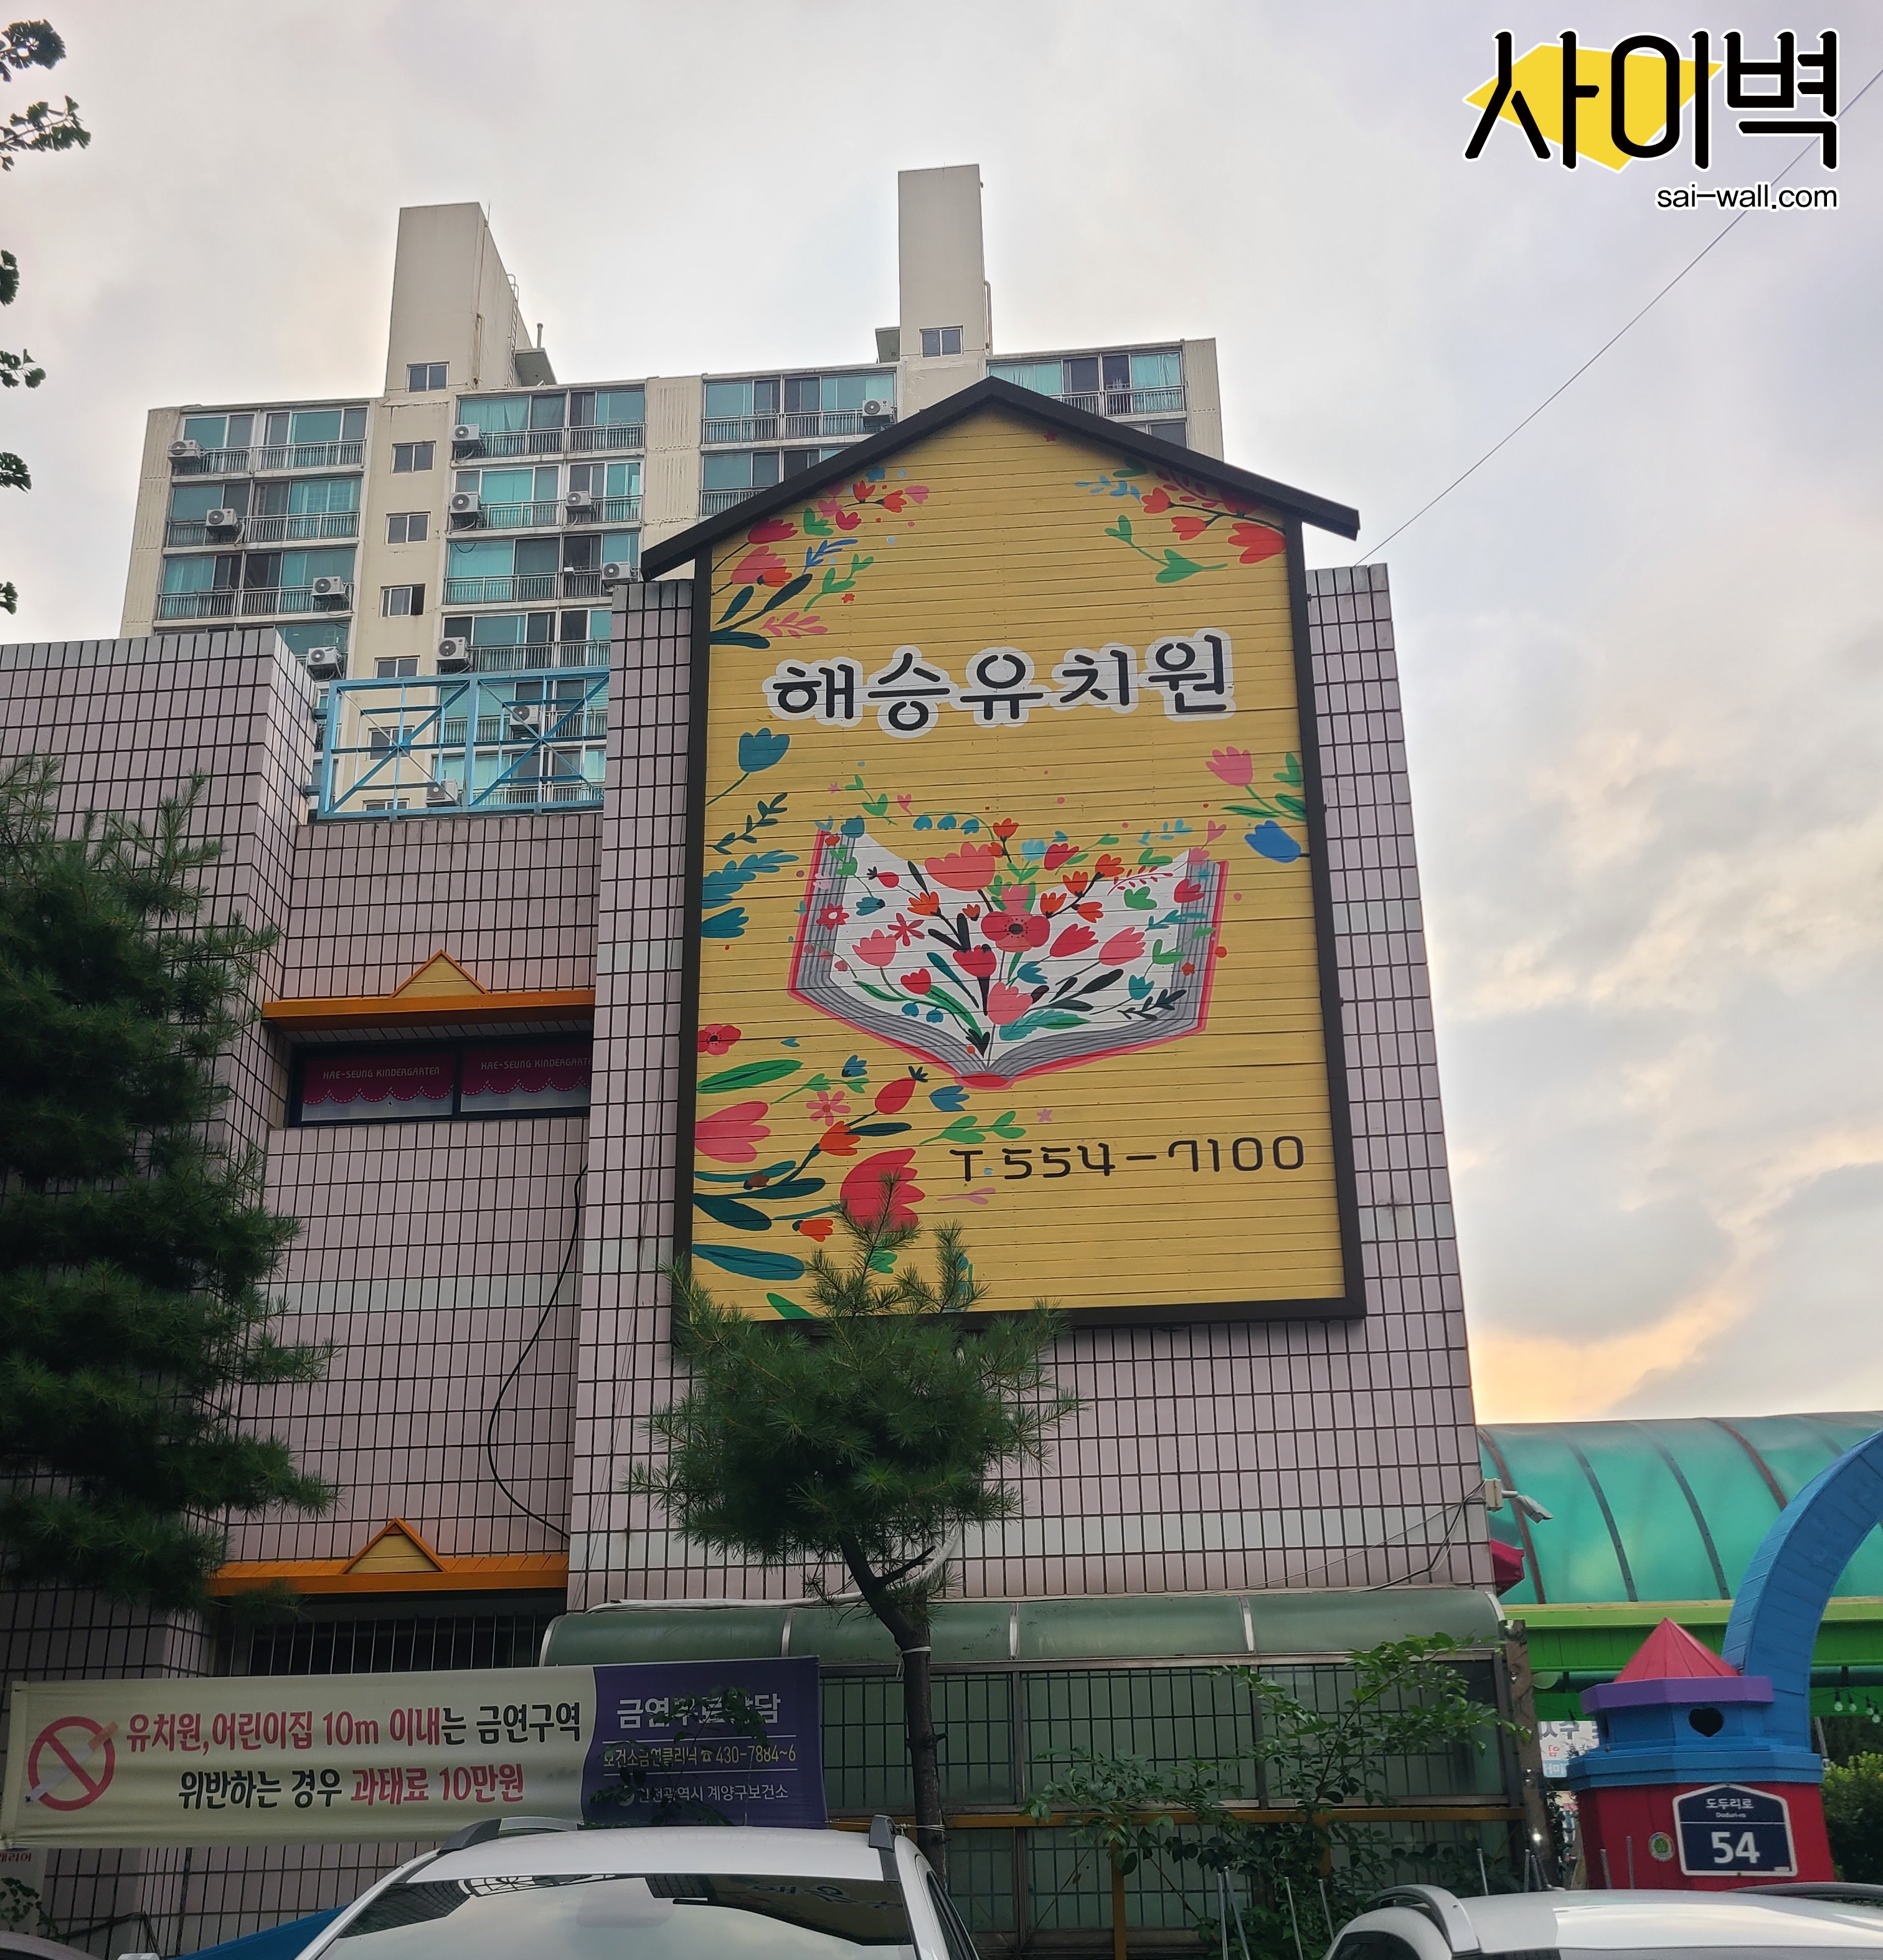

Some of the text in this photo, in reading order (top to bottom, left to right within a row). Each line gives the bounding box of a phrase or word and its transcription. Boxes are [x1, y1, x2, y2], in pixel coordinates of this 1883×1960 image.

[772, 634, 1225, 731] 해승유치원
[481, 1057, 592, 1070] HAE-SEUNG KINDERGARTE
[323, 1066, 440, 1080] HAE-SEUNG KINDERGARTEN
[323, 1710, 379, 1746] 10m
[390, 1707, 467, 1746] 이내는
[476, 1702, 581, 1744] 금연구역
[716, 1745, 796, 1763] 430-7884~6
[178, 1763, 524, 1810] 위반하는 경우 과태료 10만원
[707, 1784, 789, 1801] 계양구보건소
[1706, 1798, 1755, 1810] 도두리로
[1711, 1831, 1760, 1863] 54
